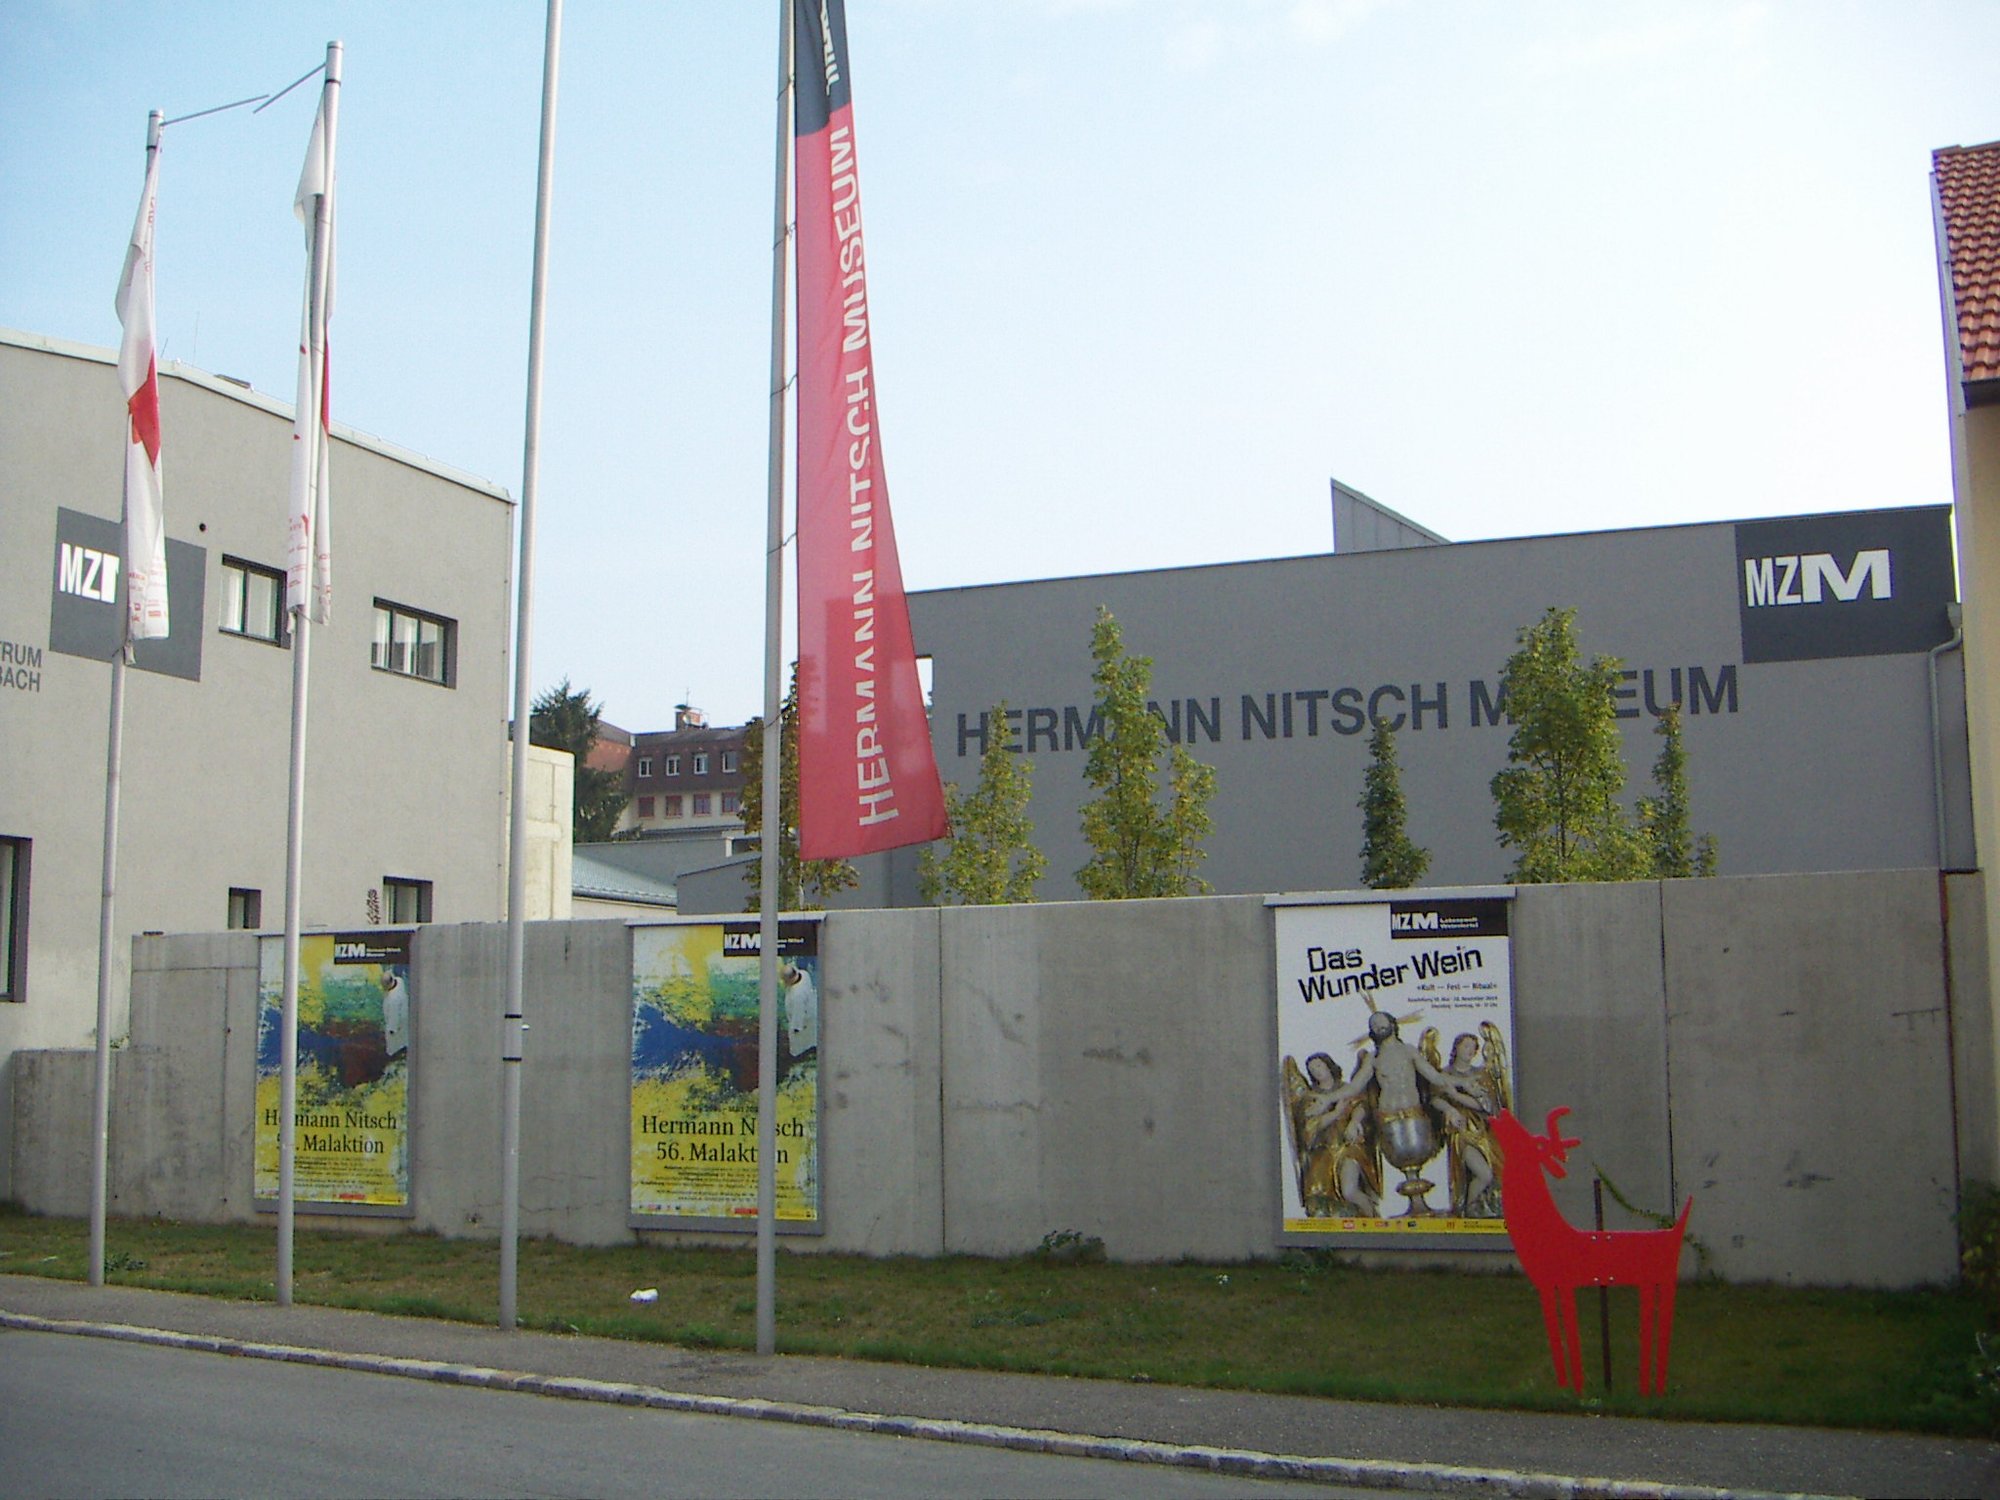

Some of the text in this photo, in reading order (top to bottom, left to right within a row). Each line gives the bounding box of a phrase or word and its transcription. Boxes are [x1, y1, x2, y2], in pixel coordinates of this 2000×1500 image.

[830, 125, 869, 354] MUSEUM
[846, 366, 873, 553] NITSCH
[1744, 549, 1892, 607] MZM
[0, 640, 42, 668] RUM
[852, 569, 900, 826] HERMANN
[957, 664, 1738, 757] HERMNN NITSCH MEUM
[1298, 946, 1483, 1003] Wunder Wein
[1307, 947, 1363, 973] Das
[264, 1109, 397, 1130] Hmann Nitsch
[642, 1115, 804, 1137] Hermann Nsch
[303, 1133, 384, 1154] Malaktion
[656, 1142, 789, 1163] 56. Malaktn
